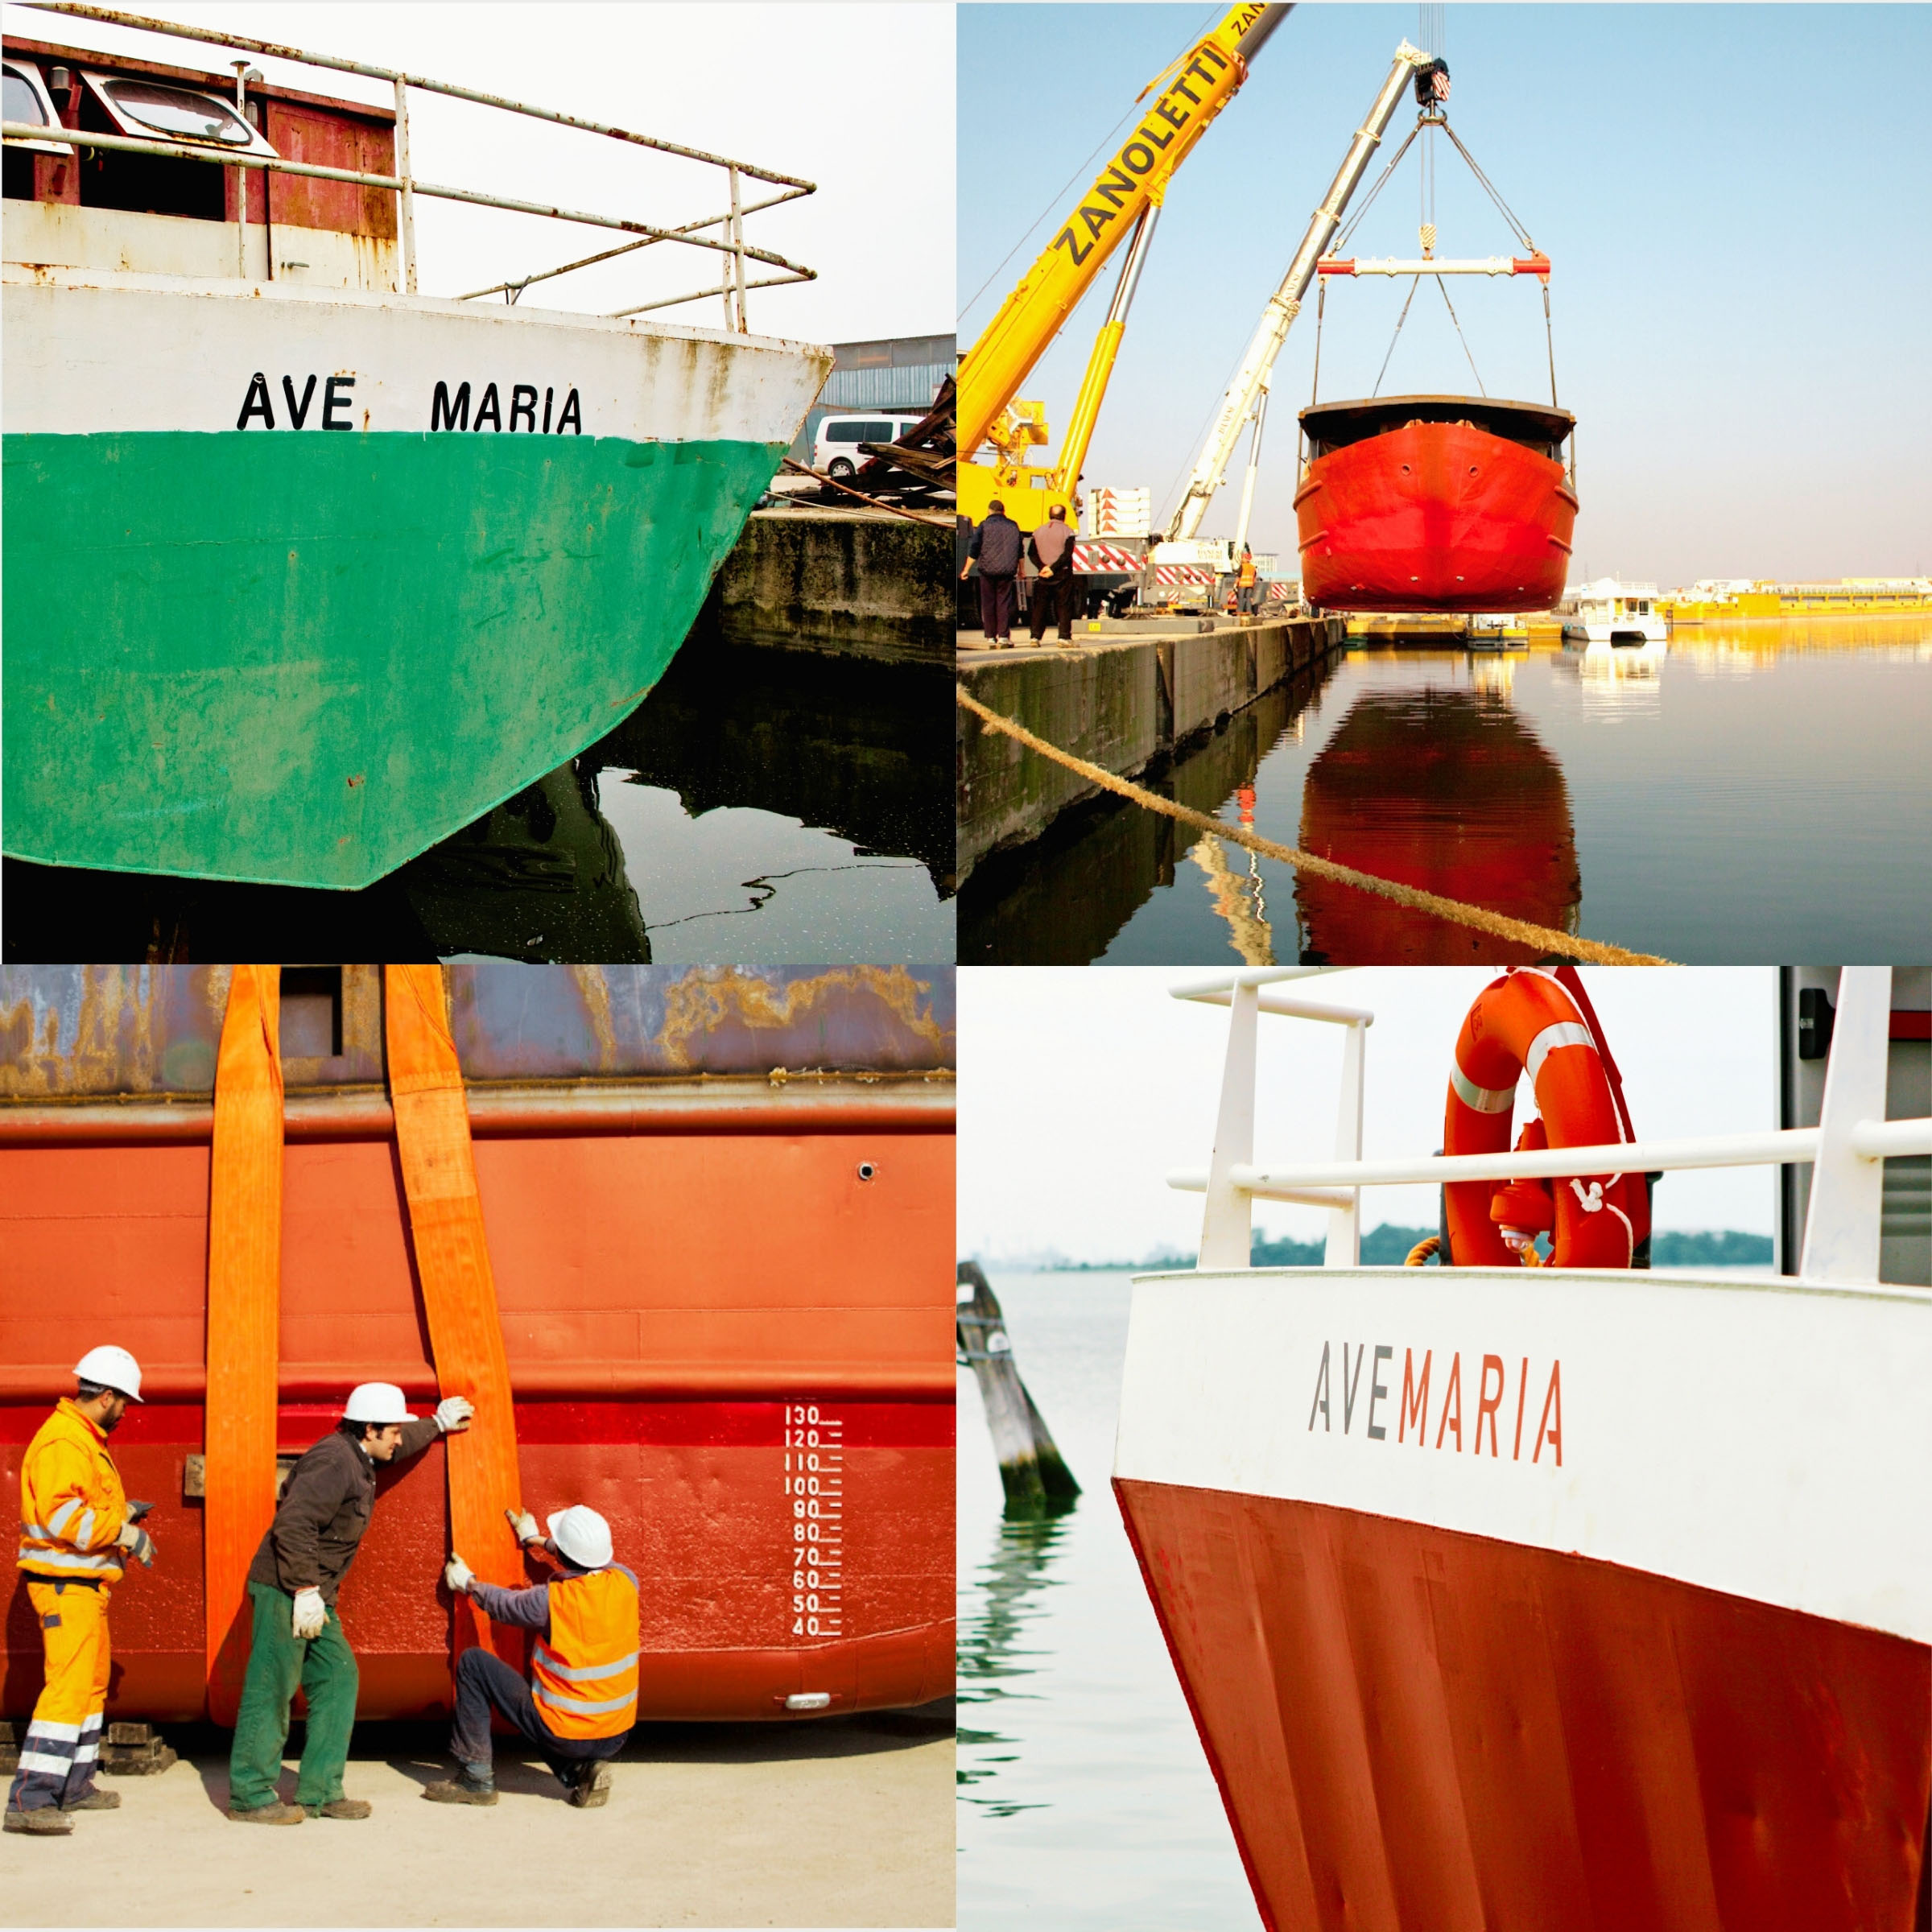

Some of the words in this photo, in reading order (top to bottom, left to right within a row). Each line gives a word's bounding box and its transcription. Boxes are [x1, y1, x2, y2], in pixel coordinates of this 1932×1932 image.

[1054, 47, 1228, 266] ZANOLETTI
[237, 372, 356, 431] AVE
[431, 381, 581, 436] MARIA
[785, 1406, 819, 1426] 130
[785, 1429, 819, 1448] 120
[785, 1453, 819, 1472] 110
[785, 1476, 819, 1496] 100
[794, 1499, 819, 1518] 90
[794, 1523, 819, 1542] 80
[793, 1547, 819, 1567] 70
[793, 1570, 819, 1589] 60
[793, 1594, 819, 1612] 50
[792, 1616, 819, 1636] 40
